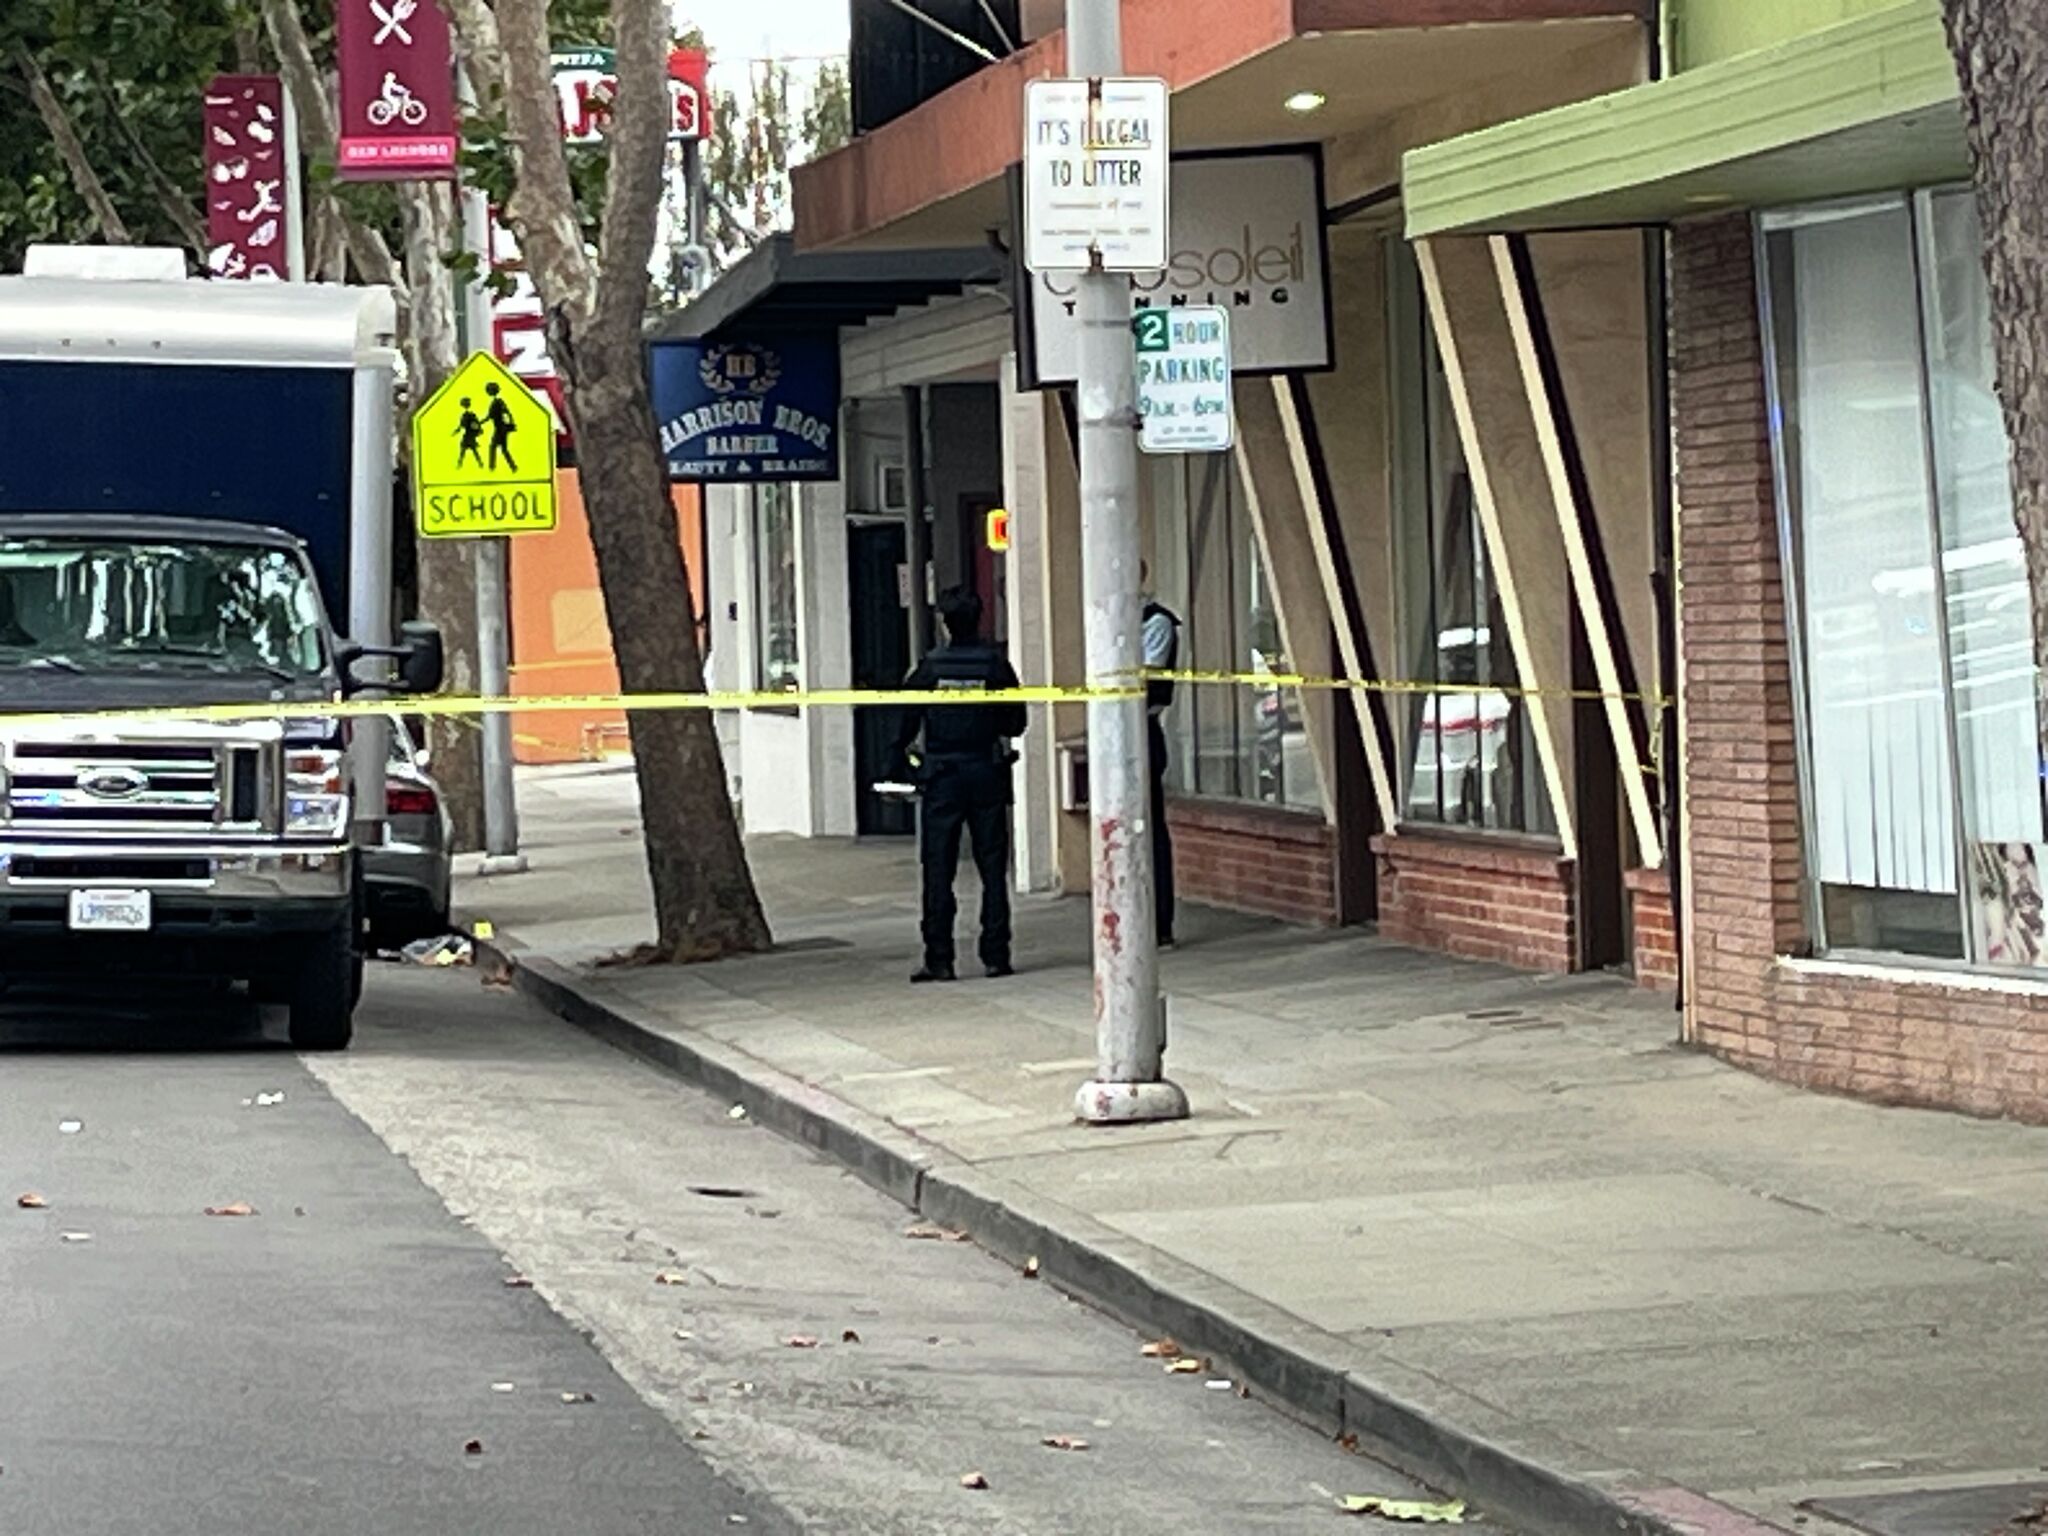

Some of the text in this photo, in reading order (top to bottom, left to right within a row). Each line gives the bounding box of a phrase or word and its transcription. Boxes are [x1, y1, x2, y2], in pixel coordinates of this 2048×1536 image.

[1037, 117, 1151, 147] IT'S ILLEGAL
[1049, 159, 1142, 187] TO LITTER
[1061, 287, 1290, 317] TNNING
[1141, 314, 1221, 347] 2 HOUR
[1137, 356, 1225, 384] PARKING
[429, 490, 548, 524] SCHOOL
